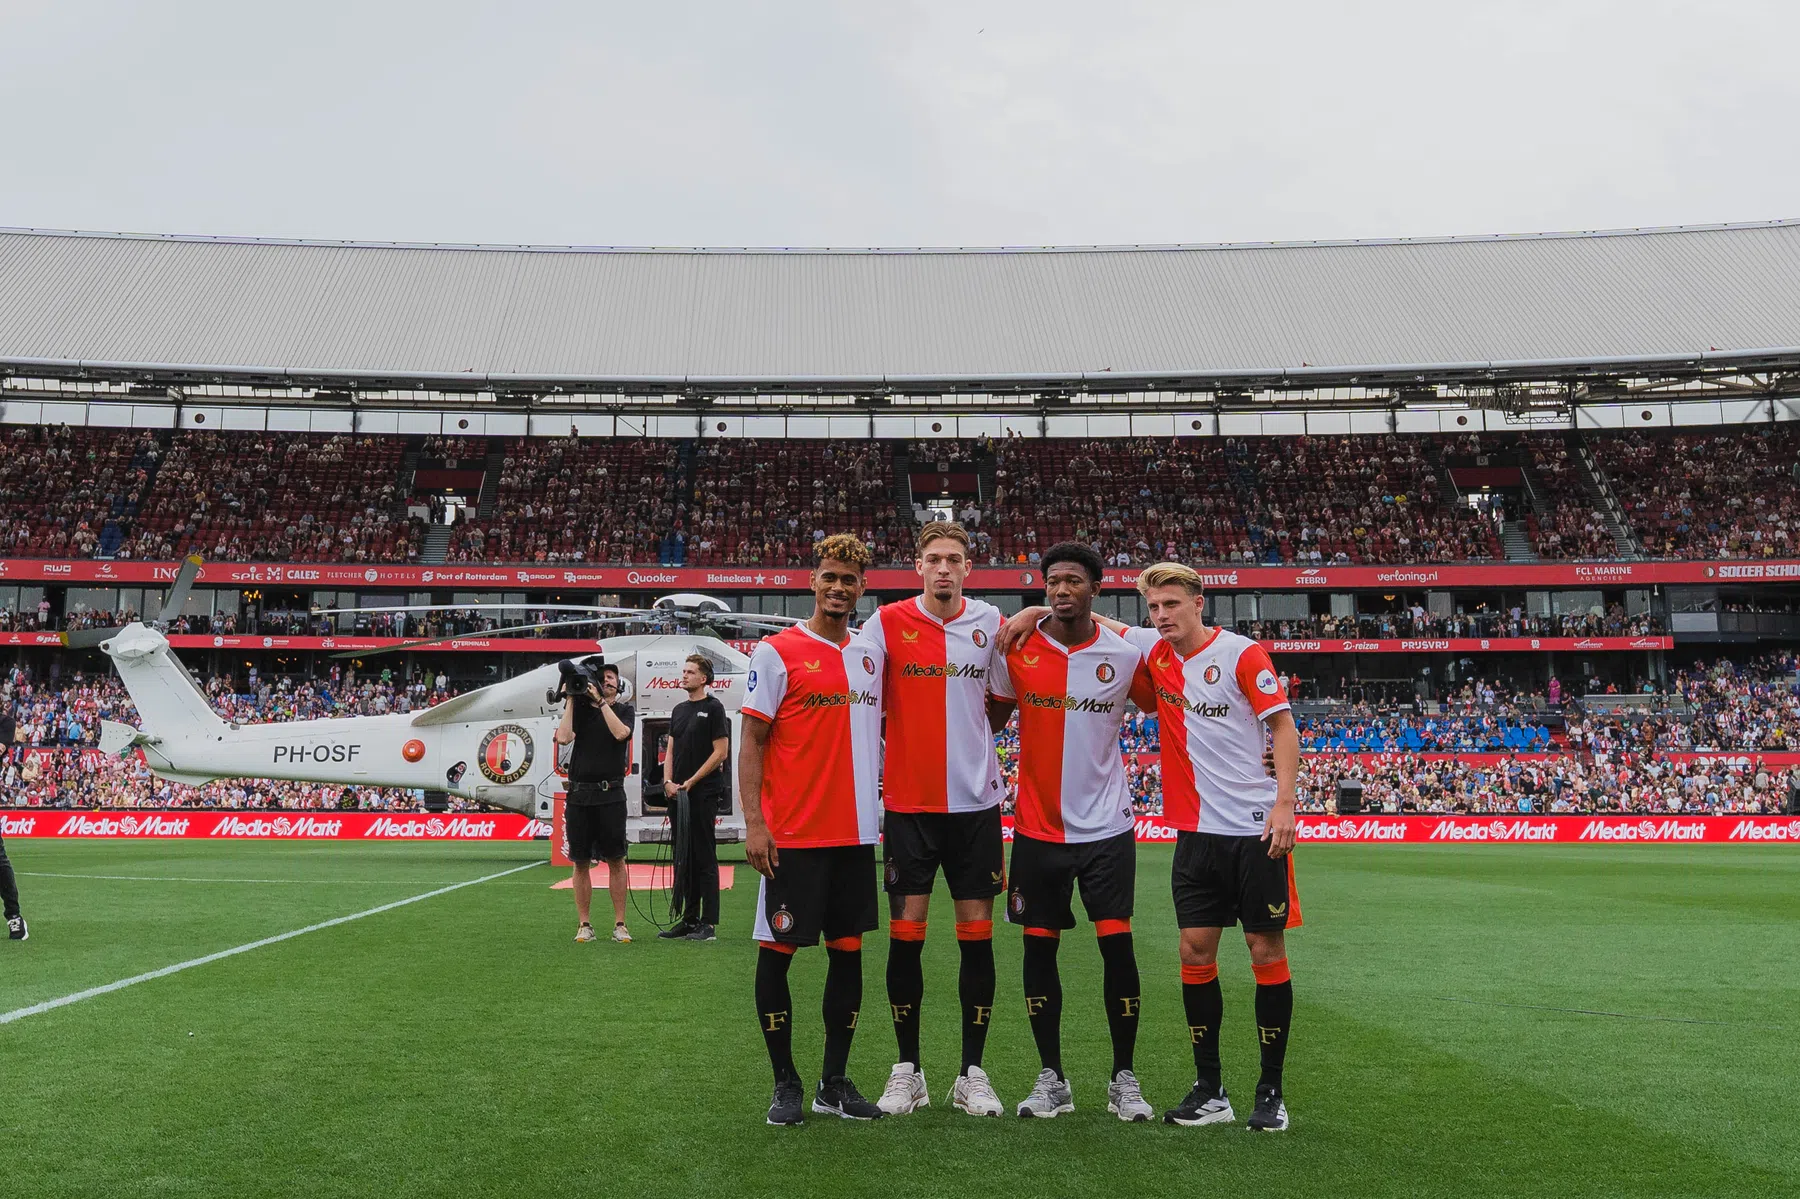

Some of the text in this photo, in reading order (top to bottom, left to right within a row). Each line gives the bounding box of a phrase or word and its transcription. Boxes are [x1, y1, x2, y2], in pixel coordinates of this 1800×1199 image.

[627, 571, 678, 584] Quooker
[707, 574, 752, 583] Heineken
[1377, 569, 1438, 583] verloning.nl
[1595, 566, 1632, 574] MARINE
[1719, 564, 1800, 578] SOCCER SCHO
[902, 662, 944, 677] Media
[708, 677, 732, 689] arkt
[803, 692, 847, 709] Media
[1023, 691, 1114, 714] Media Markt
[1193, 702, 1229, 717] Markt
[483, 725, 531, 745] FEYENOORD
[273, 745, 361, 763] PH-OSF
[480, 761, 530, 783] ROTTERDAM
[57, 816, 190, 835] Media Markt
[210, 817, 342, 836] Media Markt
[364, 818, 426, 837] Media
[442, 818, 495, 837] Markt
[1354, 820, 1407, 839] Markt
[1430, 821, 1557, 840] Media Markt
[1579, 821, 1706, 840] Media Markt
[1729, 821, 1788, 840] Media
[891, 1004, 911, 1023] F
[973, 1005, 992, 1024] F
[1026, 996, 1047, 1016] F
[1120, 996, 1140, 1016] F
[765, 1010, 787, 1031] F
[1189, 1025, 1208, 1043] F
[1258, 1026, 1281, 1044] F
